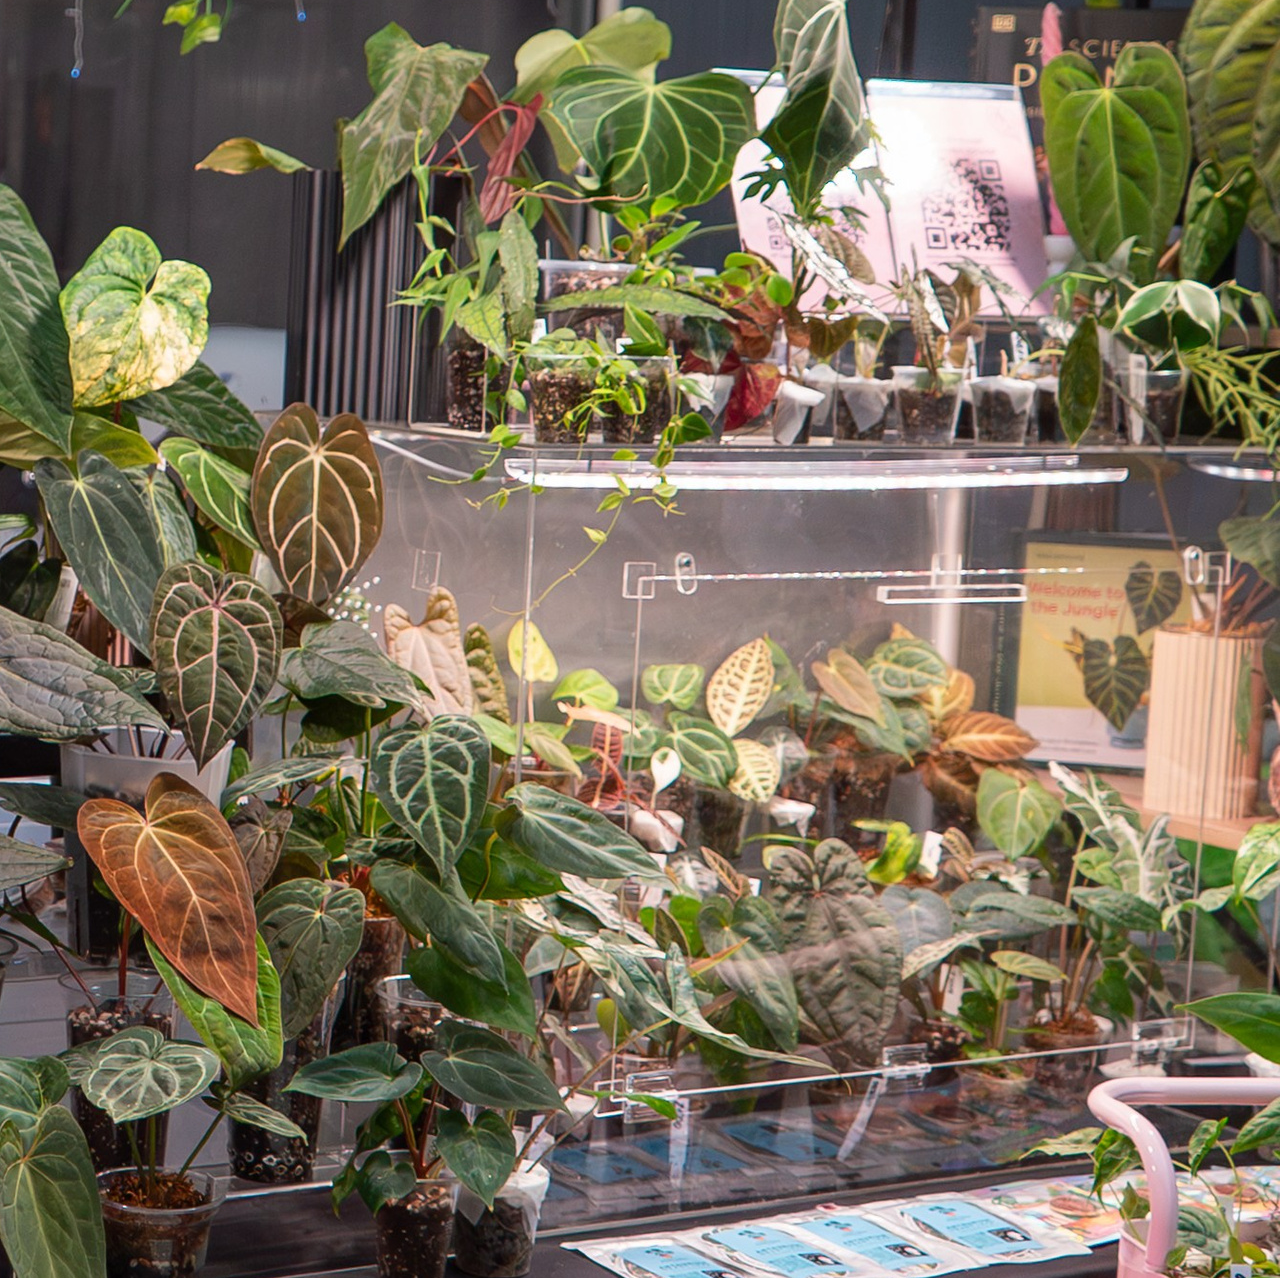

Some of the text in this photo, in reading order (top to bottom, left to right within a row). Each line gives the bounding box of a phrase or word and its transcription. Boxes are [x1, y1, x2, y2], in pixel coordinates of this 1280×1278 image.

[1029, 581, 1125, 600] Welcome to
[1030, 601, 1118, 619] the Jungle
